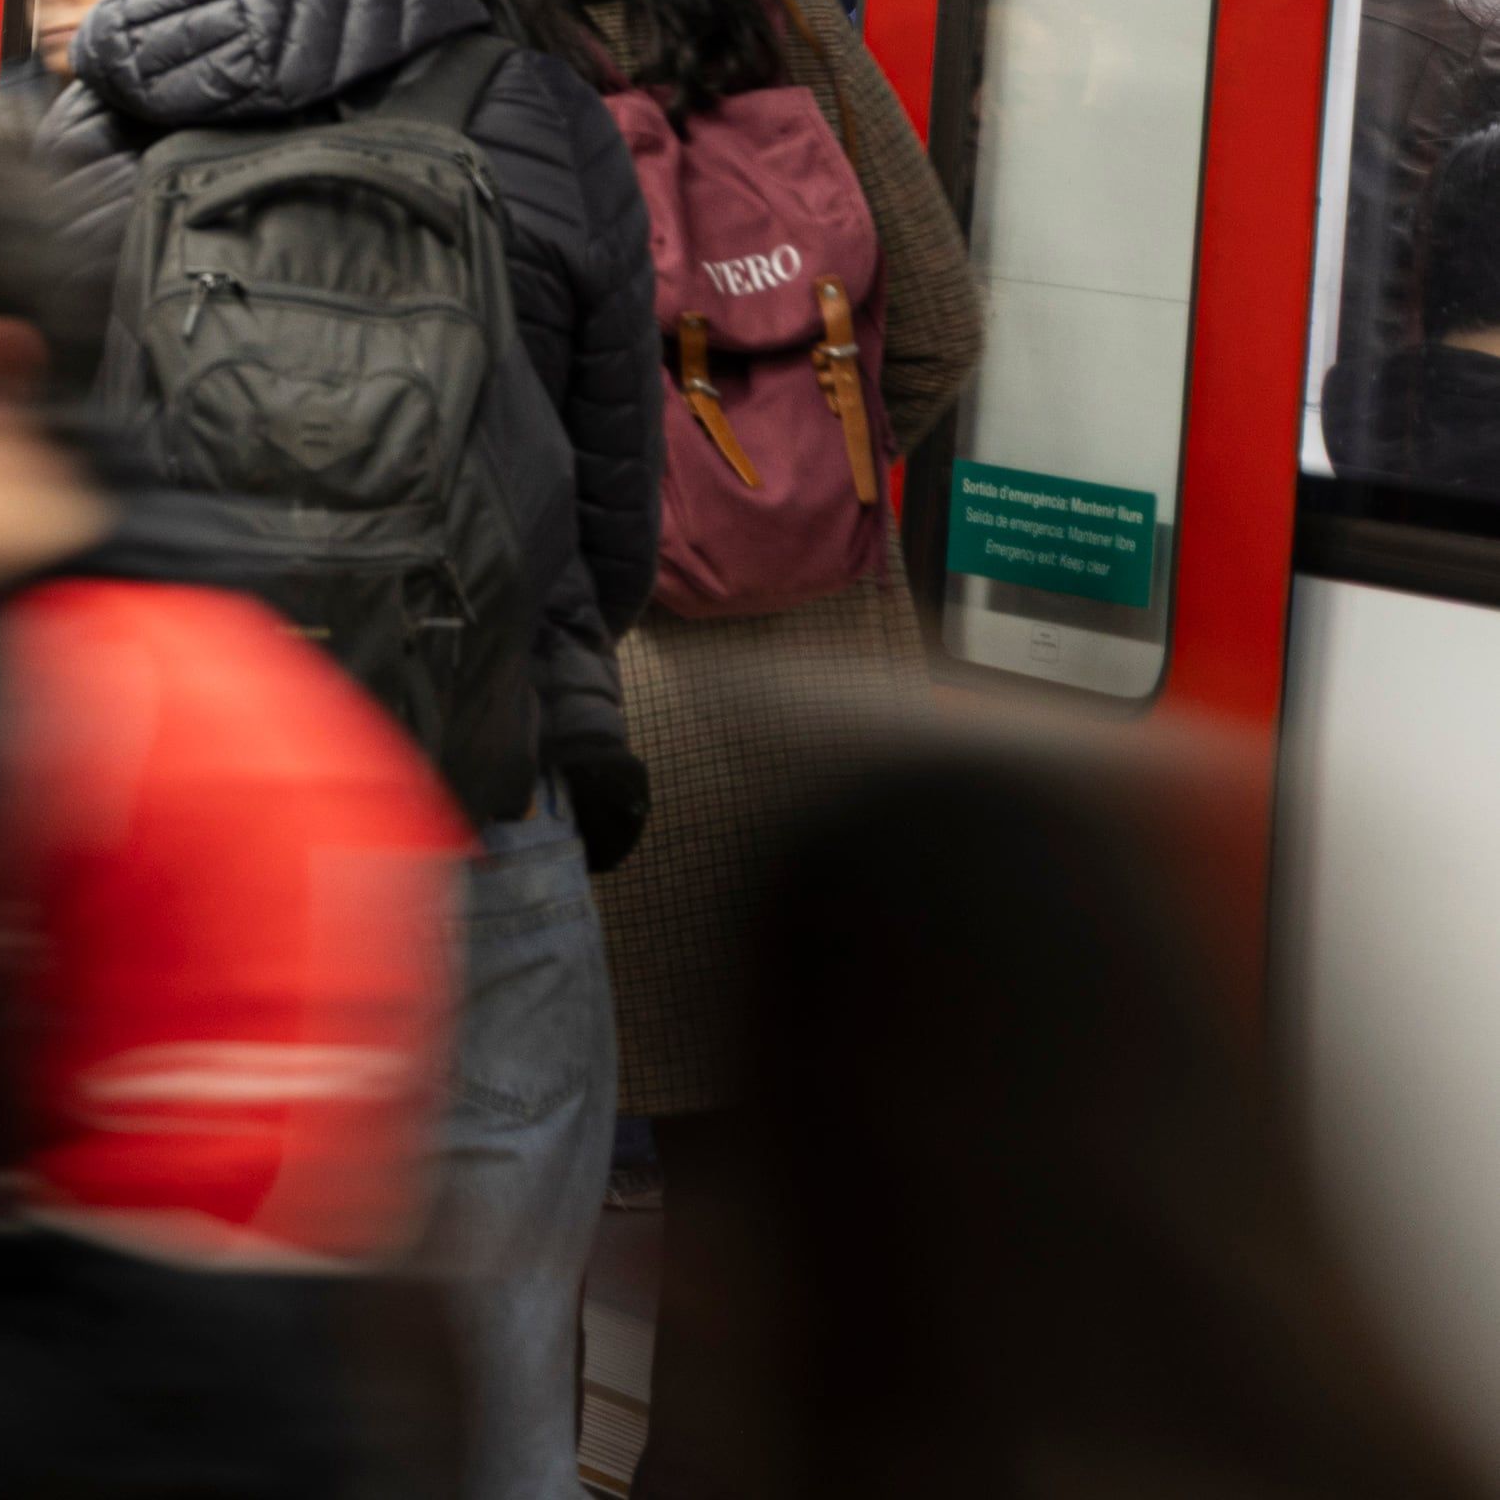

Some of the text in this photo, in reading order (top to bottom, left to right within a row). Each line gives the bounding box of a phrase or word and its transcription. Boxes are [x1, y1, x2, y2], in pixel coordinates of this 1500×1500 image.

[702, 244, 801, 296] VERO
[963, 478, 998, 499] Sortida
[1071, 496, 1116, 519] Mantenir
[966, 506, 994, 526] Salida
[995, 512, 1008, 529] de
[1068, 525, 1114, 547] Mantener
[985, 539, 1036, 565] Emergency
